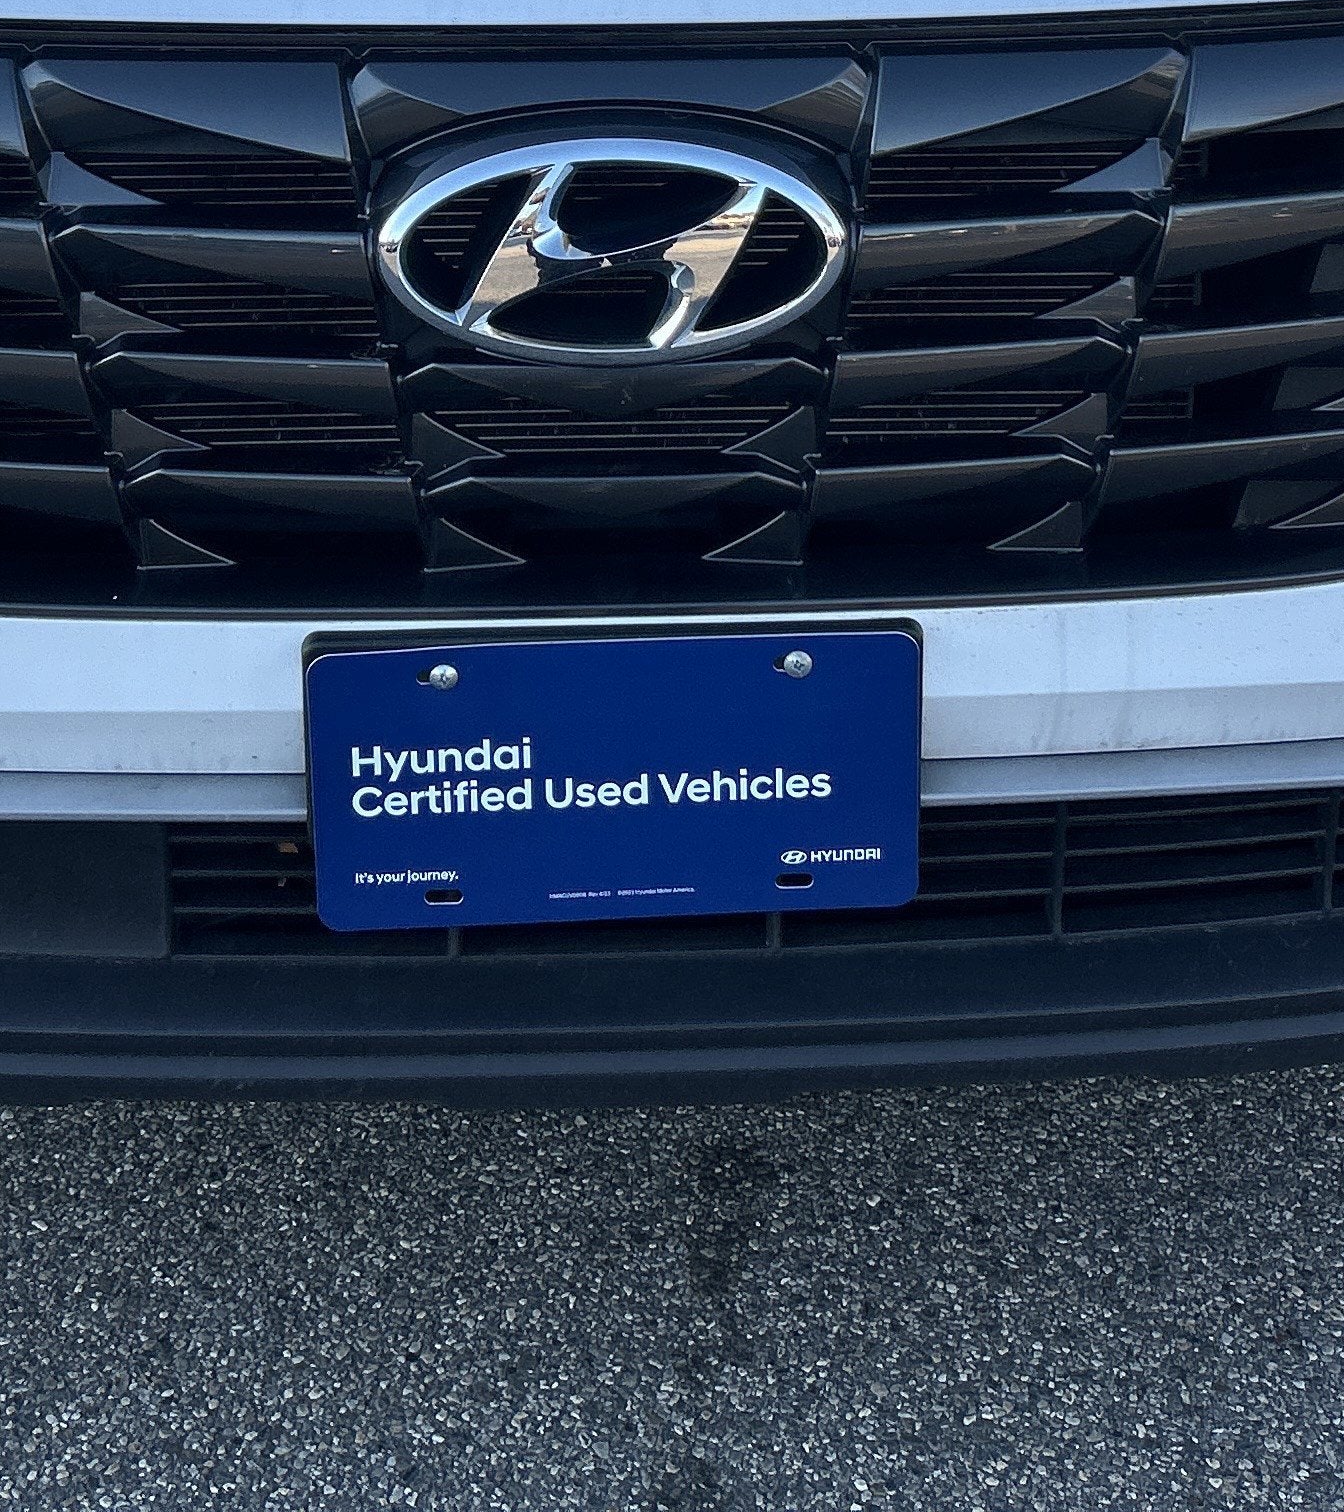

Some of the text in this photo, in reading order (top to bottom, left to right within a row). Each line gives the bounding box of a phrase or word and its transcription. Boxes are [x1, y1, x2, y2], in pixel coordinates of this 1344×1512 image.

[351, 737, 532, 782] Hyundai
[351, 767, 833, 818] Certified Used Vehicles
[810, 847, 881, 862] HYUNDAI
[355, 869, 459, 885] It's your journey.
